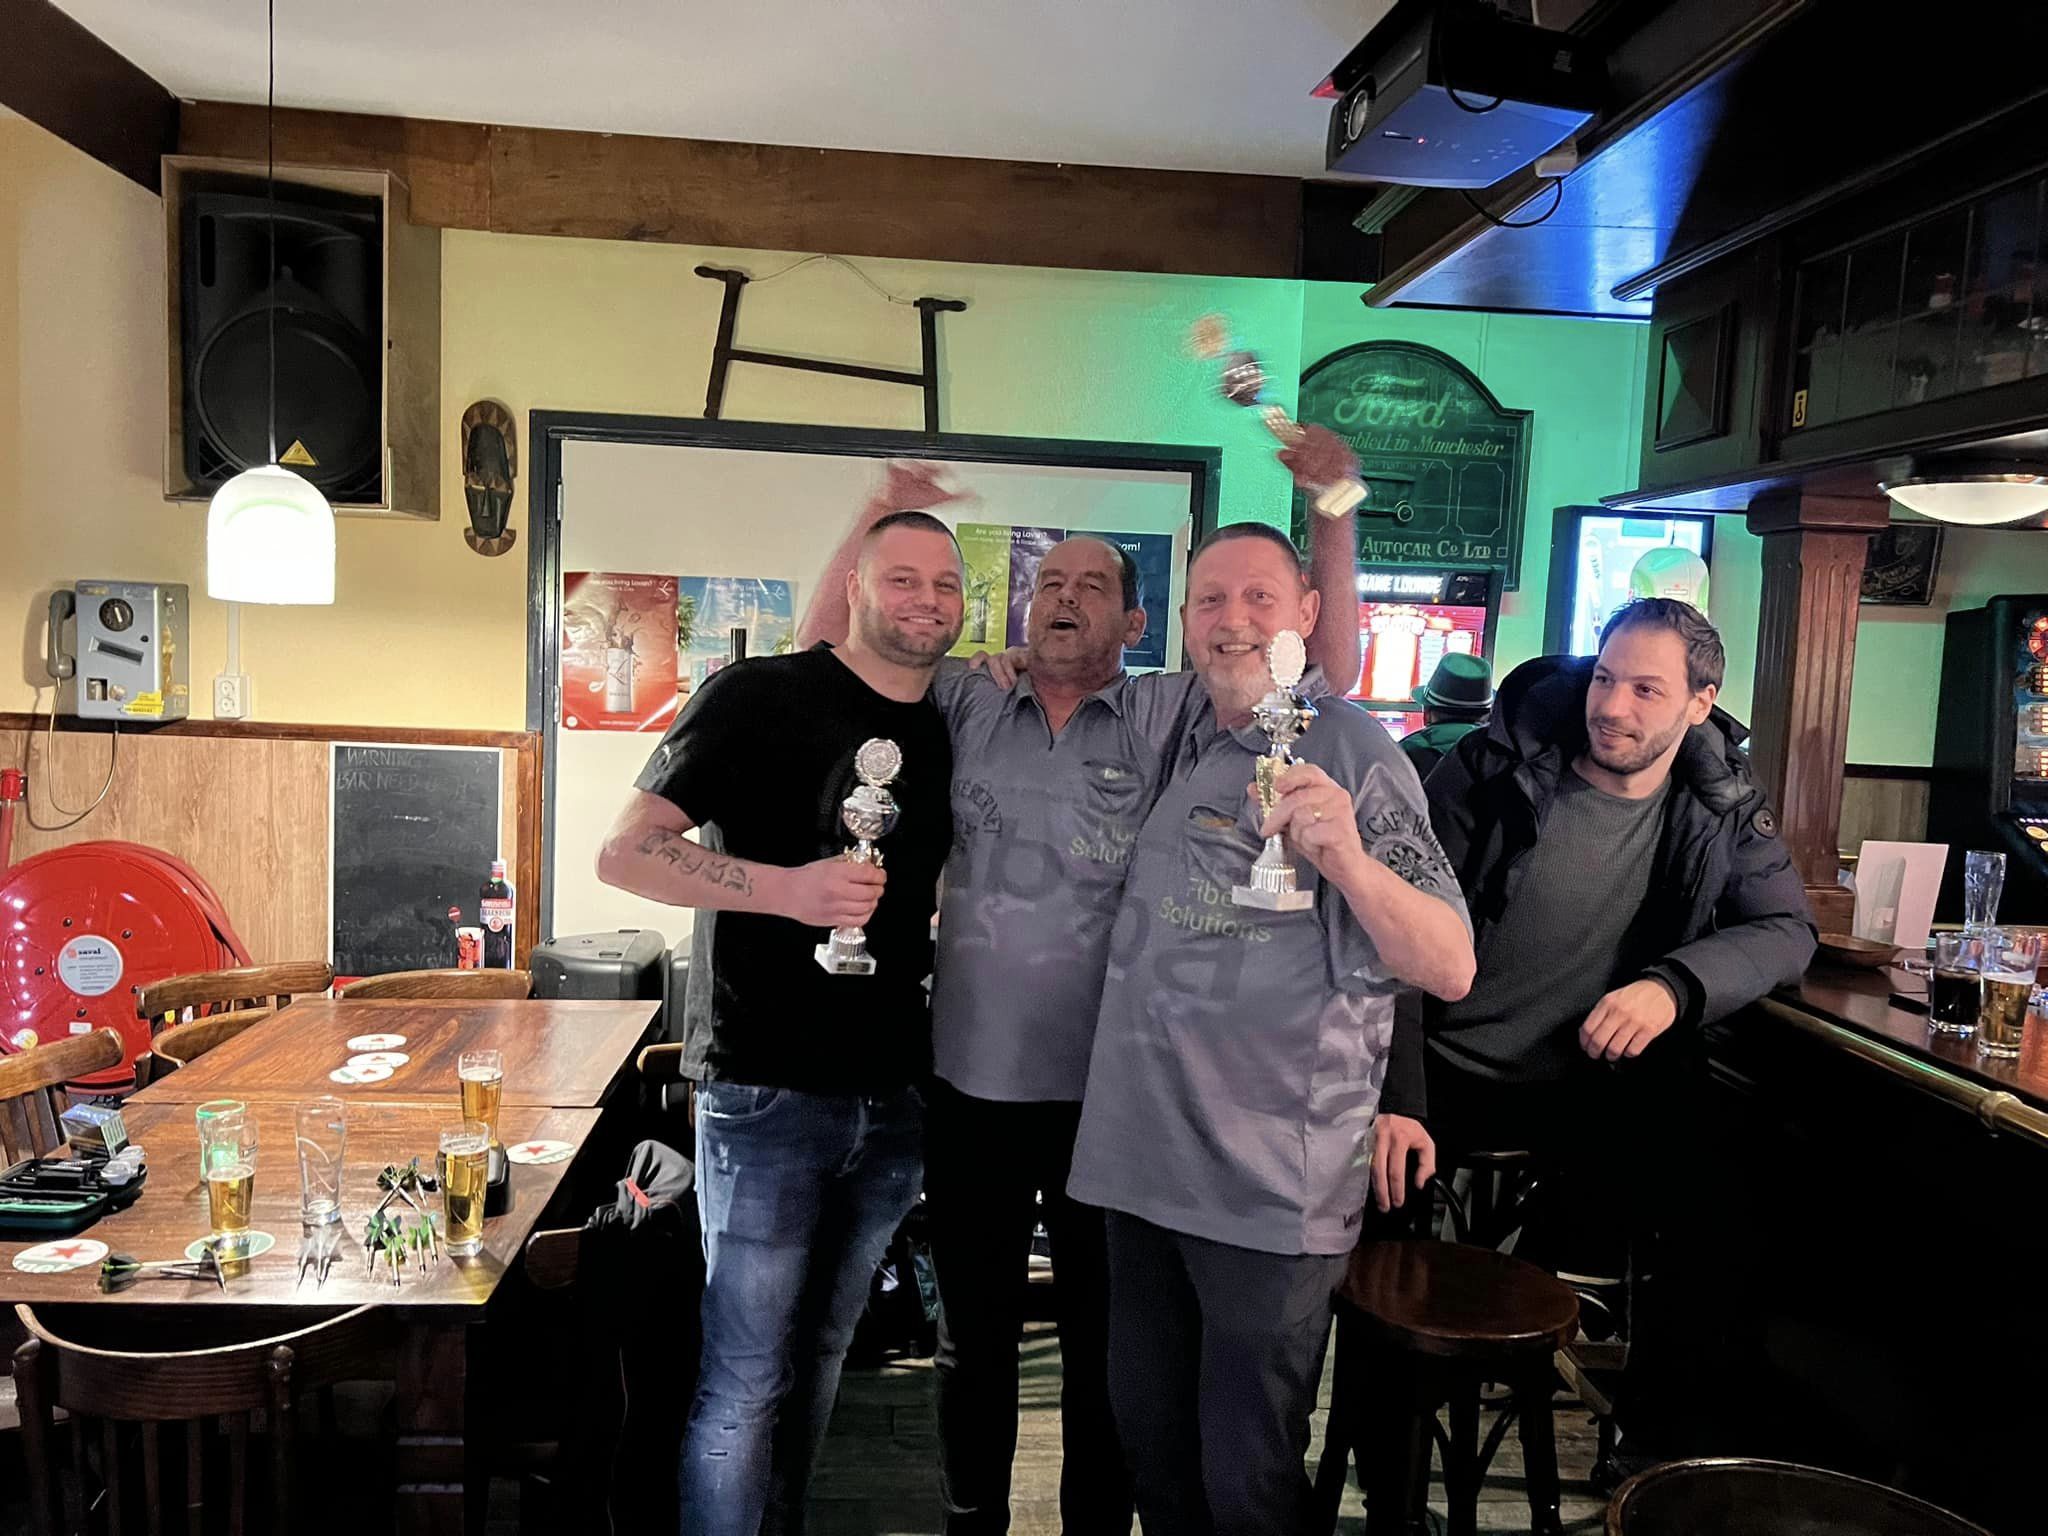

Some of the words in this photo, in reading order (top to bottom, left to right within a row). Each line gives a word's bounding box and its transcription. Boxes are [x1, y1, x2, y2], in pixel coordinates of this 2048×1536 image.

[1334, 374, 1452, 429] Ford
[1394, 433, 1410, 452] in
[1414, 435, 1504, 457] Manchester
[1362, 537, 1433, 557] AUTOCAR
[1463, 541, 1491, 559] LTD
[1394, 574, 1444, 593] LOUNGE
[1186, 876, 1241, 910] Fibe
[1157, 895, 1273, 944] Solutions
